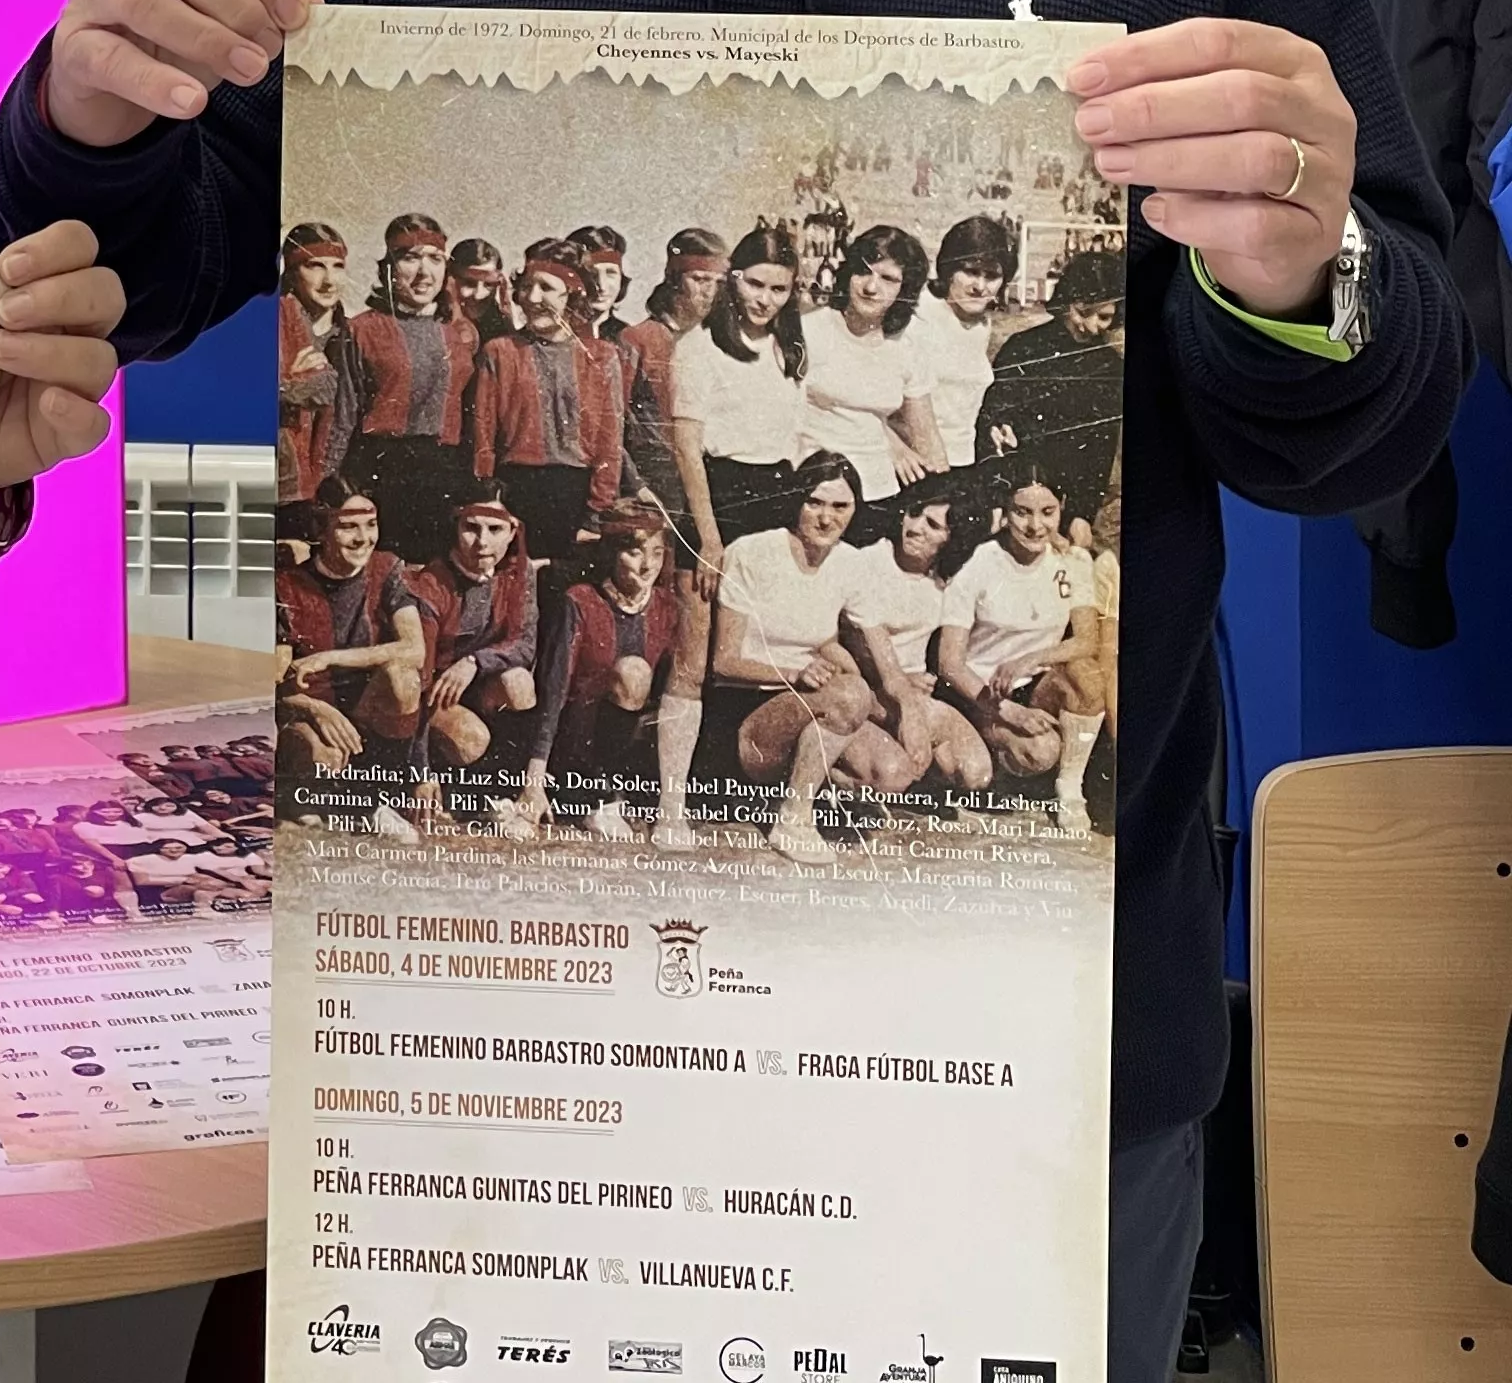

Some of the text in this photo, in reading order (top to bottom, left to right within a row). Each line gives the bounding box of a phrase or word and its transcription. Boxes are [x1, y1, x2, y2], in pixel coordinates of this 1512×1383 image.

[381, 21, 1024, 49] Invierno de 1972. Domingo, 21 de febrero. Municipal de los Deportes de Barbastro.
[597, 45, 798, 64] Cheyennes vs. Mayeski
[315, 763, 403, 783] Piedrafita;
[409, 767, 453, 785] Mari
[459, 768, 492, 786] Luz
[566, 772, 606, 790] Dori
[612, 775, 661, 794] Soler,
[667, 775, 719, 795] Isabel
[724, 778, 801, 801] Puyuelo,
[807, 783, 854, 802] Loles
[860, 786, 938, 808] Romera,
[944, 790, 981, 809] Loli
[316, 909, 629, 948] FÚTBOL FEMENINO. BARBASTRO
[315, 946, 612, 984] SÁBADO, 4 DE NOVIEMBRE 2023
[709, 967, 771, 995] Peña Ferranca
[317, 999, 356, 1019] 10 H.
[314, 1027, 1013, 1086] FÚTBOL FEMENINO BARBASTRO SOMONTANO A VS. FRAGA FÚTBOL BASE A
[314, 1088, 622, 1123] DOMINGO, 5 DE NOVIEMBRE 2023
[315, 1138, 354, 1158] 10 H.
[314, 1166, 857, 1219] PEÑA FERRANCA GUNITAS DEL PIRINEO VS. HURACÁN C.D.
[314, 1213, 353, 1234] 12 H.
[313, 1242, 794, 1292] PEÑA FERRANCA SOMONPLAK VS. VILLANUEVA C.F.
[308, 1322, 380, 1338] CLAVERIA
[497, 1345, 571, 1363] TERÉS
[801, 1373, 840, 1383] STORE
